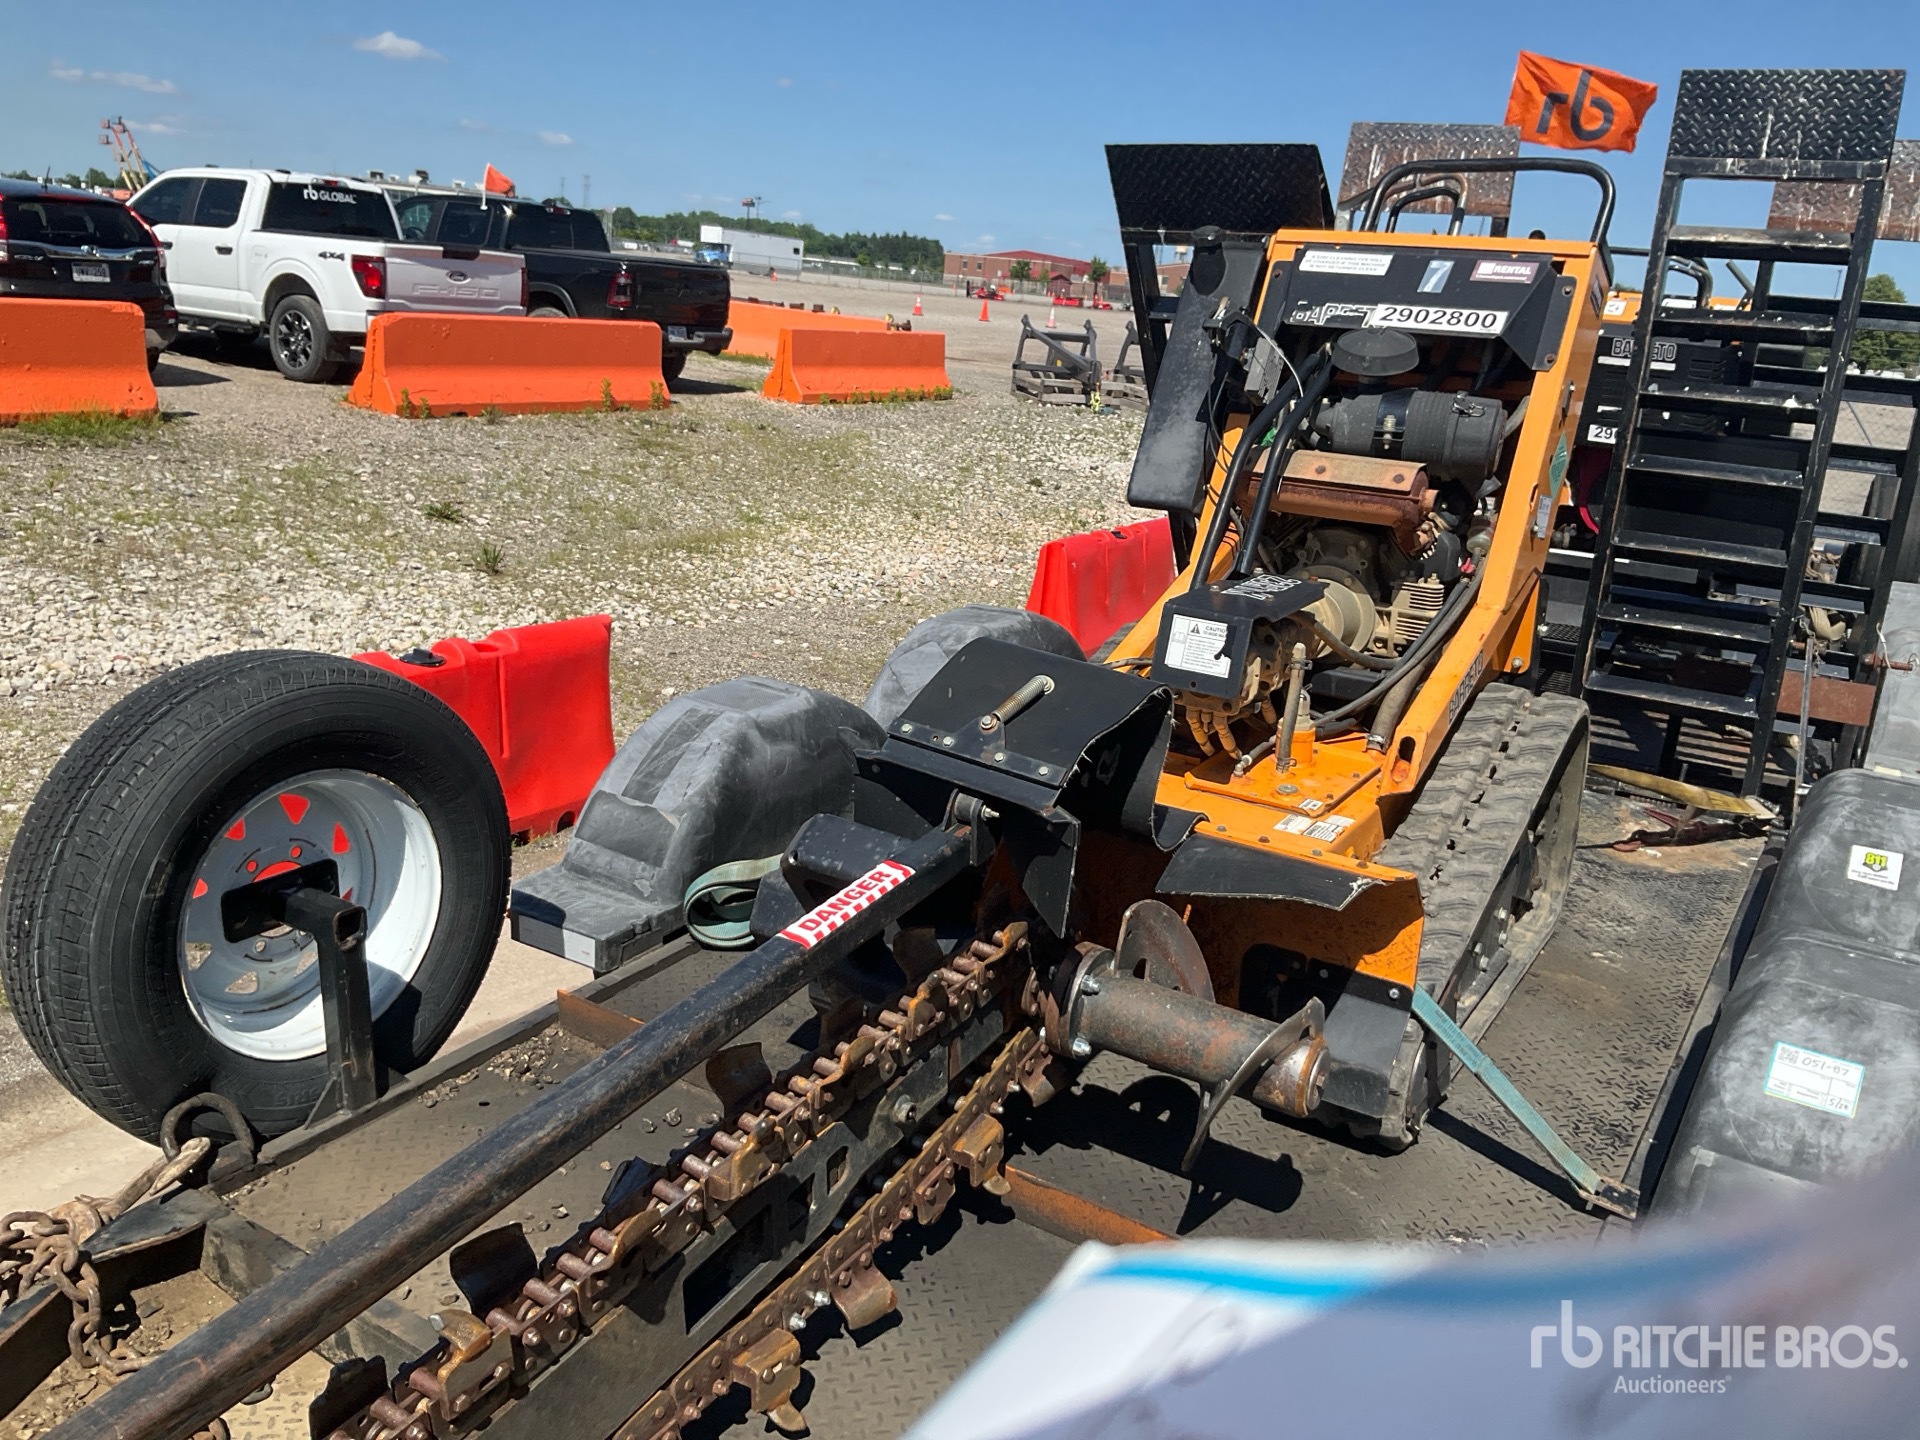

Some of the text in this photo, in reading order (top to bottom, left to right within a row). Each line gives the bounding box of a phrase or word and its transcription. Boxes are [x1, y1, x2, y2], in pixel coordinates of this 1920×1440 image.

[1536, 69, 1614, 141] rb
[319, 190, 357, 204] GLOBAL
[1494, 265, 1532, 275] RENTAL
[413, 283, 500, 299] F-150
[1379, 306, 1498, 329] 2902800
[1865, 852, 1887, 867] 811
[798, 870, 893, 931] DANGER
